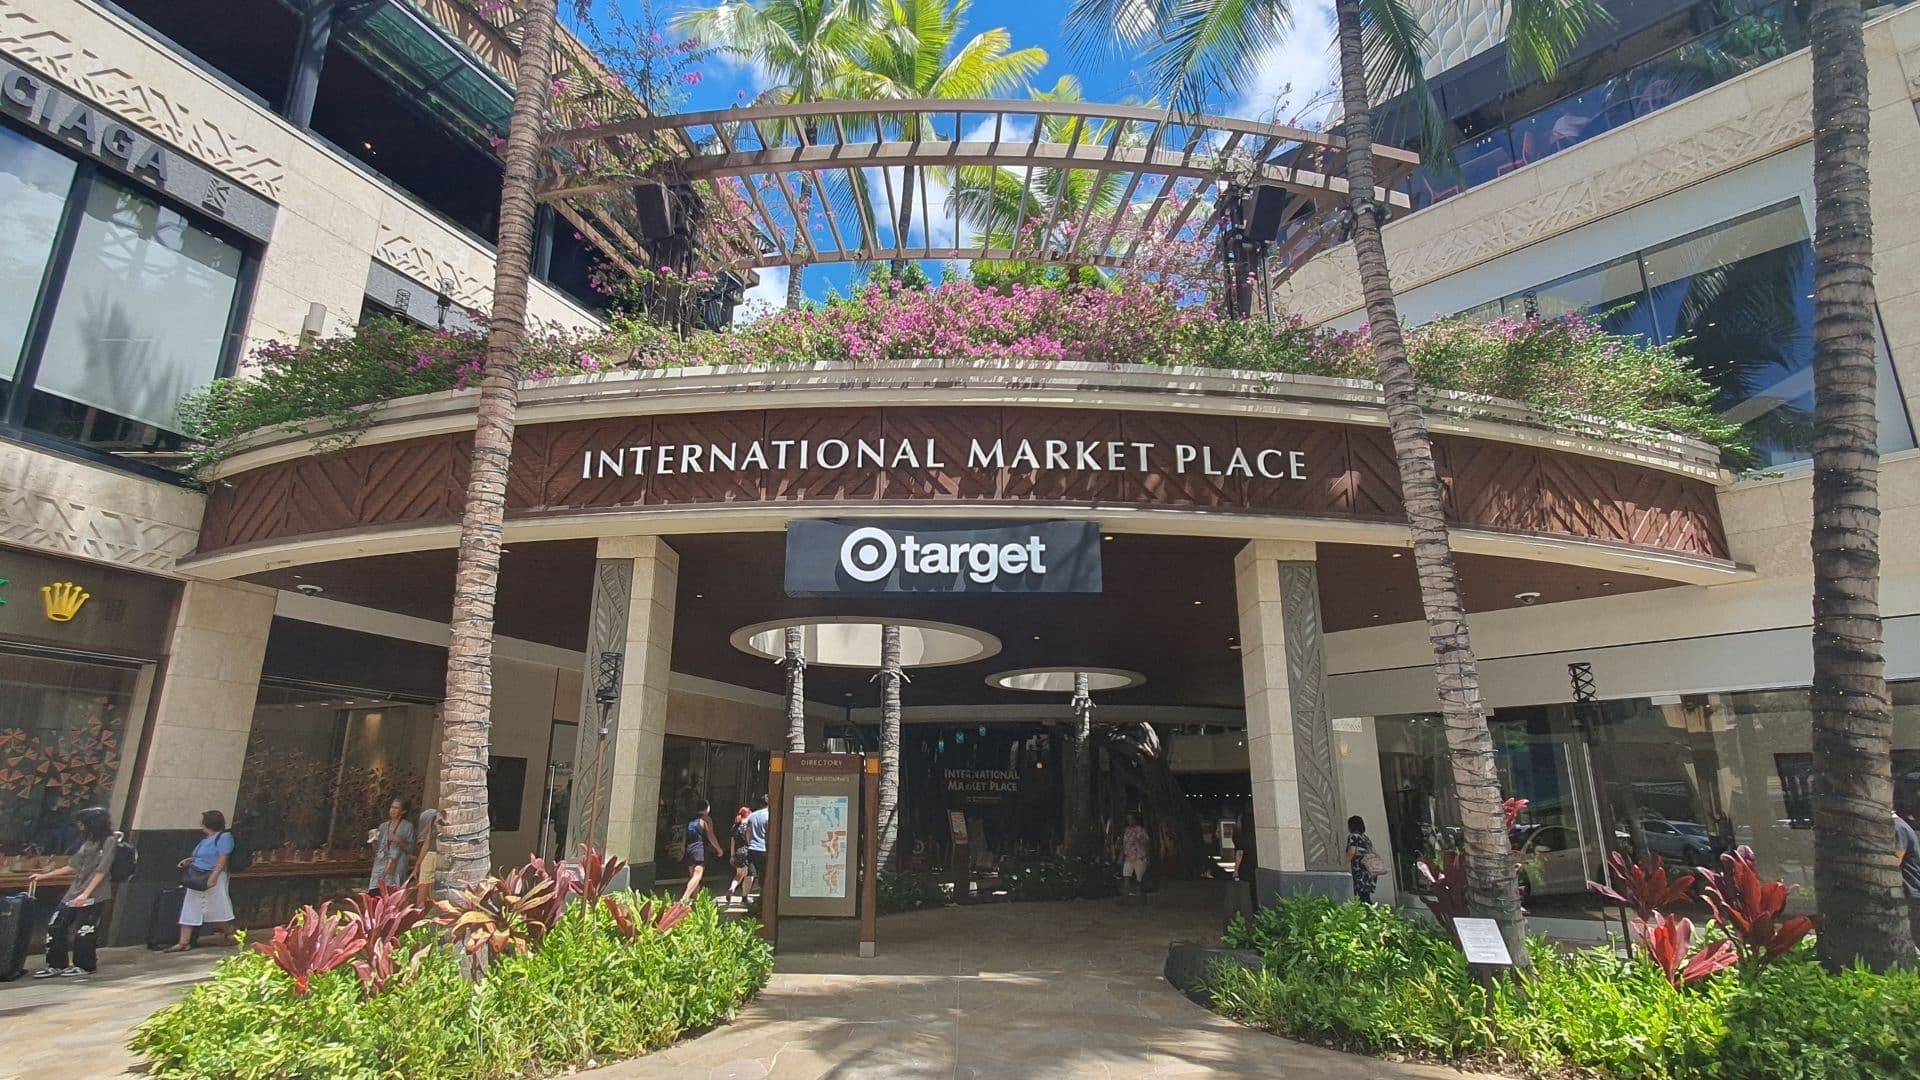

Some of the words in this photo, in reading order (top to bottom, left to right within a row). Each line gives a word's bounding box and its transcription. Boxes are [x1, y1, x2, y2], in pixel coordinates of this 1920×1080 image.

[1, 69, 168, 182] CIAGA
[582, 438, 945, 479] INTERNATIONAL
[967, 438, 1155, 473] MARKET
[1175, 444, 1307, 480] PLACE
[900, 535, 1047, 584] target
[800, 759, 843, 767] DIRECTORY
[944, 768, 1020, 779] INTERNATIONAL
[989, 781, 1018, 792] PLACE
